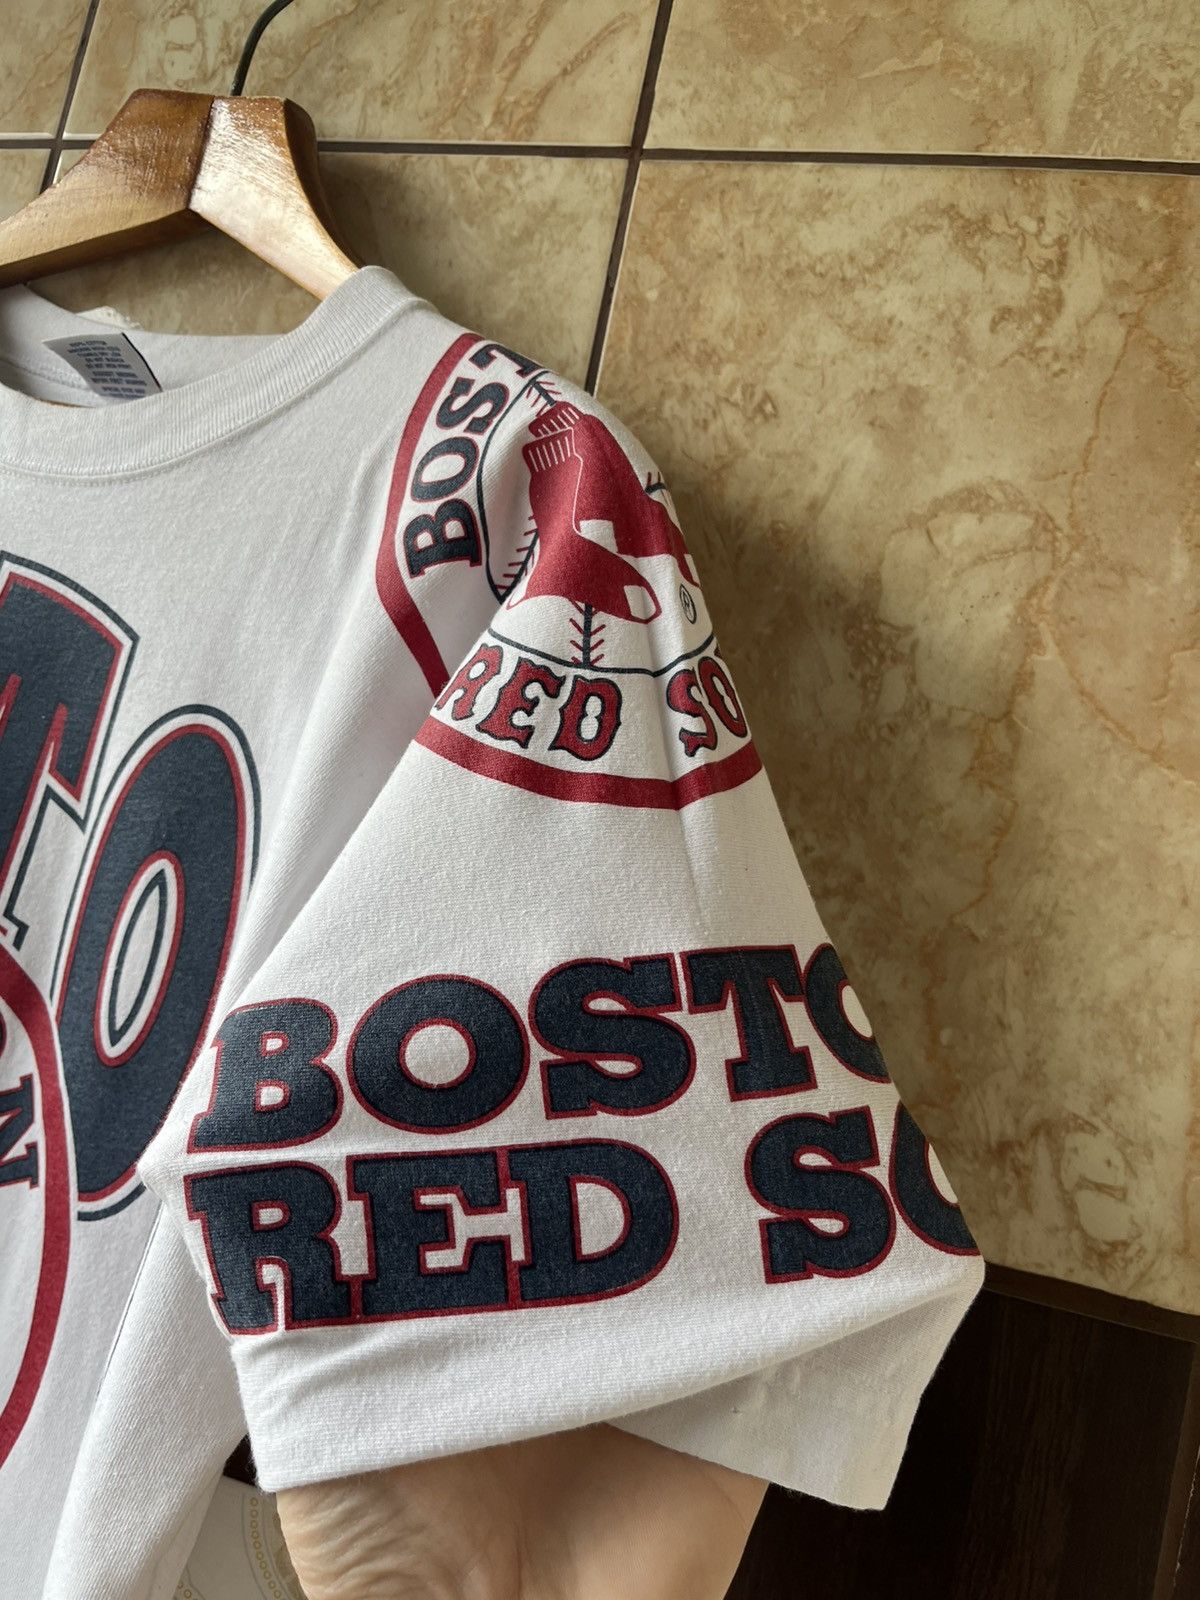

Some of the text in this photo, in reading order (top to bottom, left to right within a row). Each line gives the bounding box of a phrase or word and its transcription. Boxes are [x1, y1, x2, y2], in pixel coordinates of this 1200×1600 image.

[434, 643, 748, 761] RED SO
[187, 942, 892, 1154] BOSTO
[184, 1100, 982, 1335] RED SO
